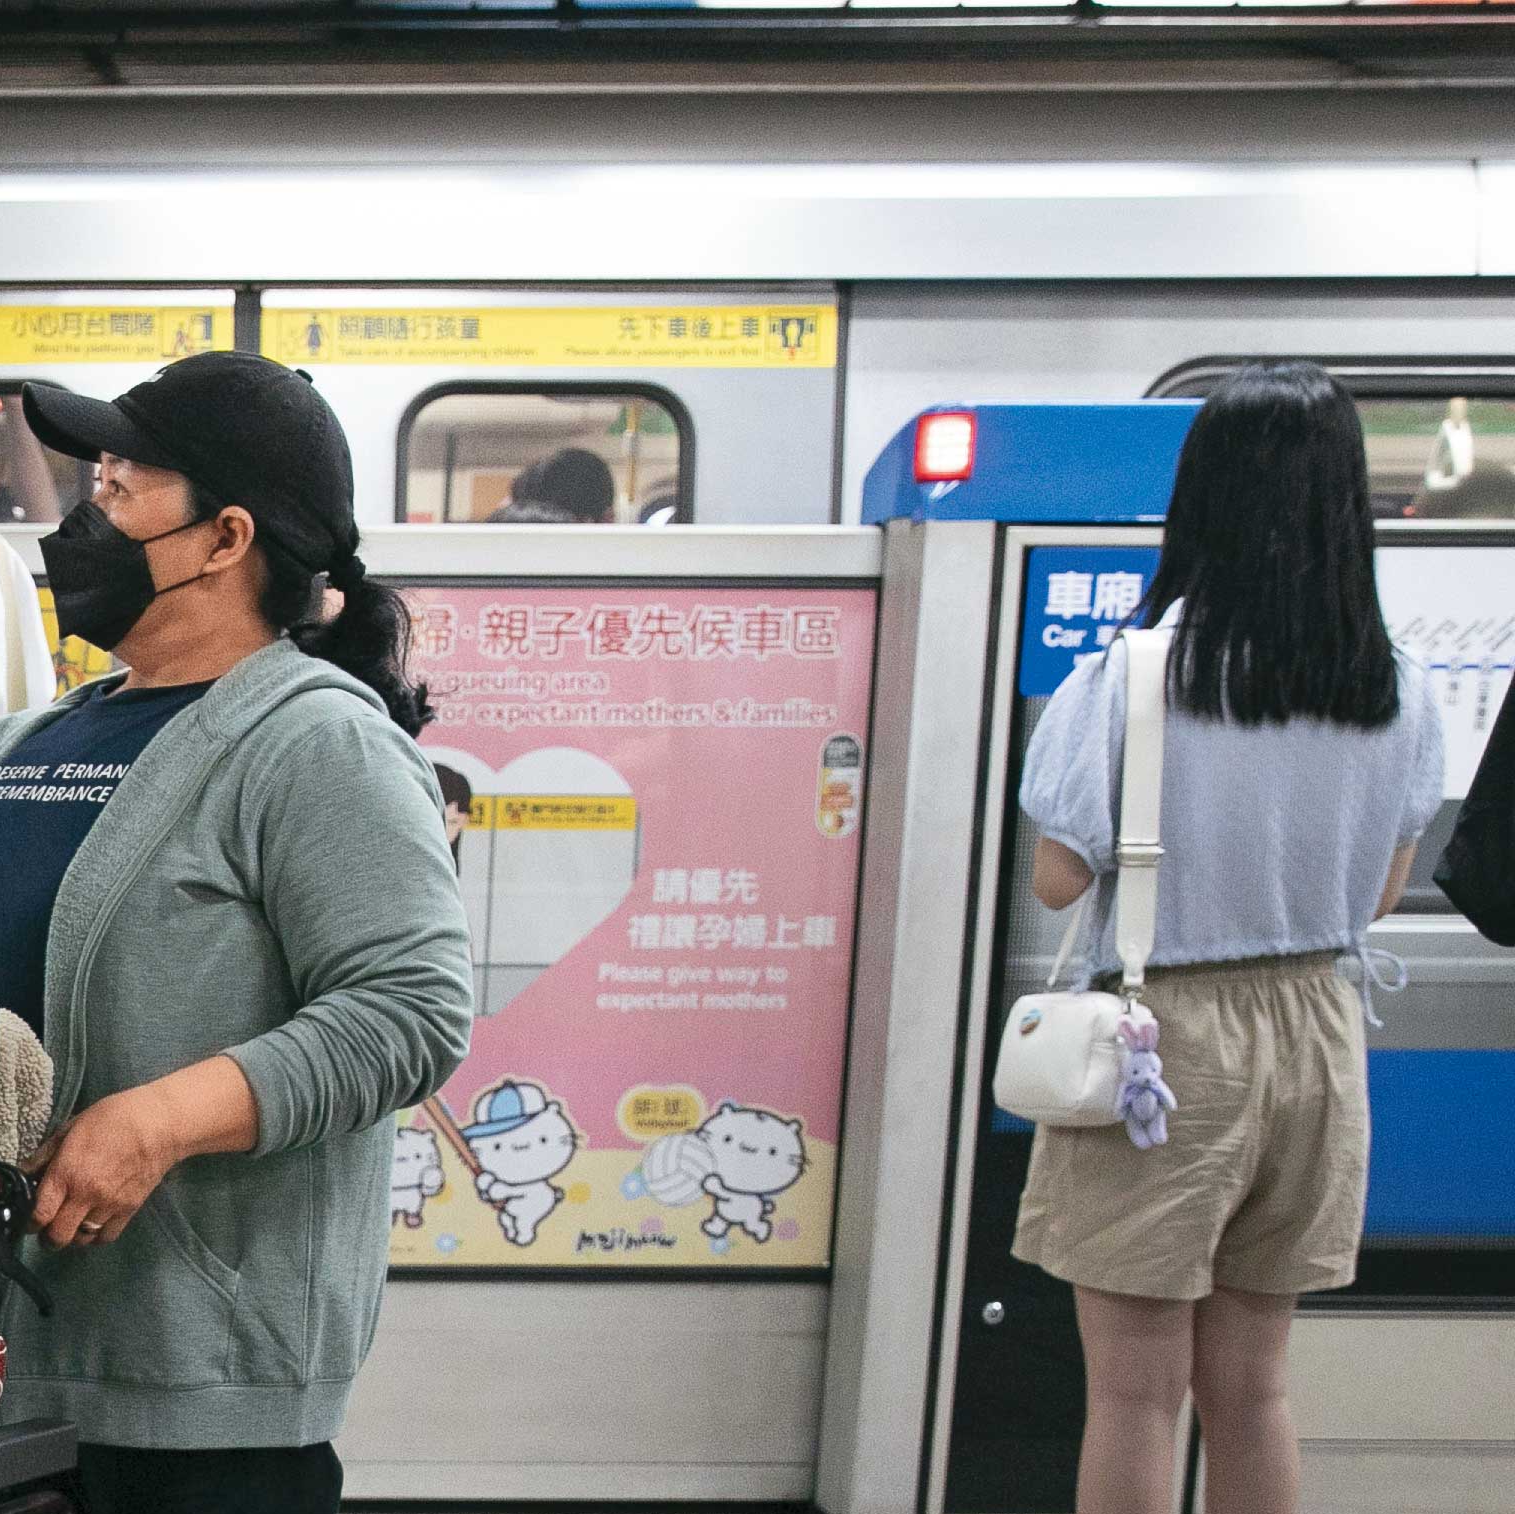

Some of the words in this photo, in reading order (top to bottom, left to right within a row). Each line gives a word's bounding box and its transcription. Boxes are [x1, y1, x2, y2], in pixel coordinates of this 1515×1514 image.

[1042, 623, 1088, 649] Car
[597, 963, 664, 983] Please
[667, 966, 712, 988] give
[717, 967, 761, 988] way
